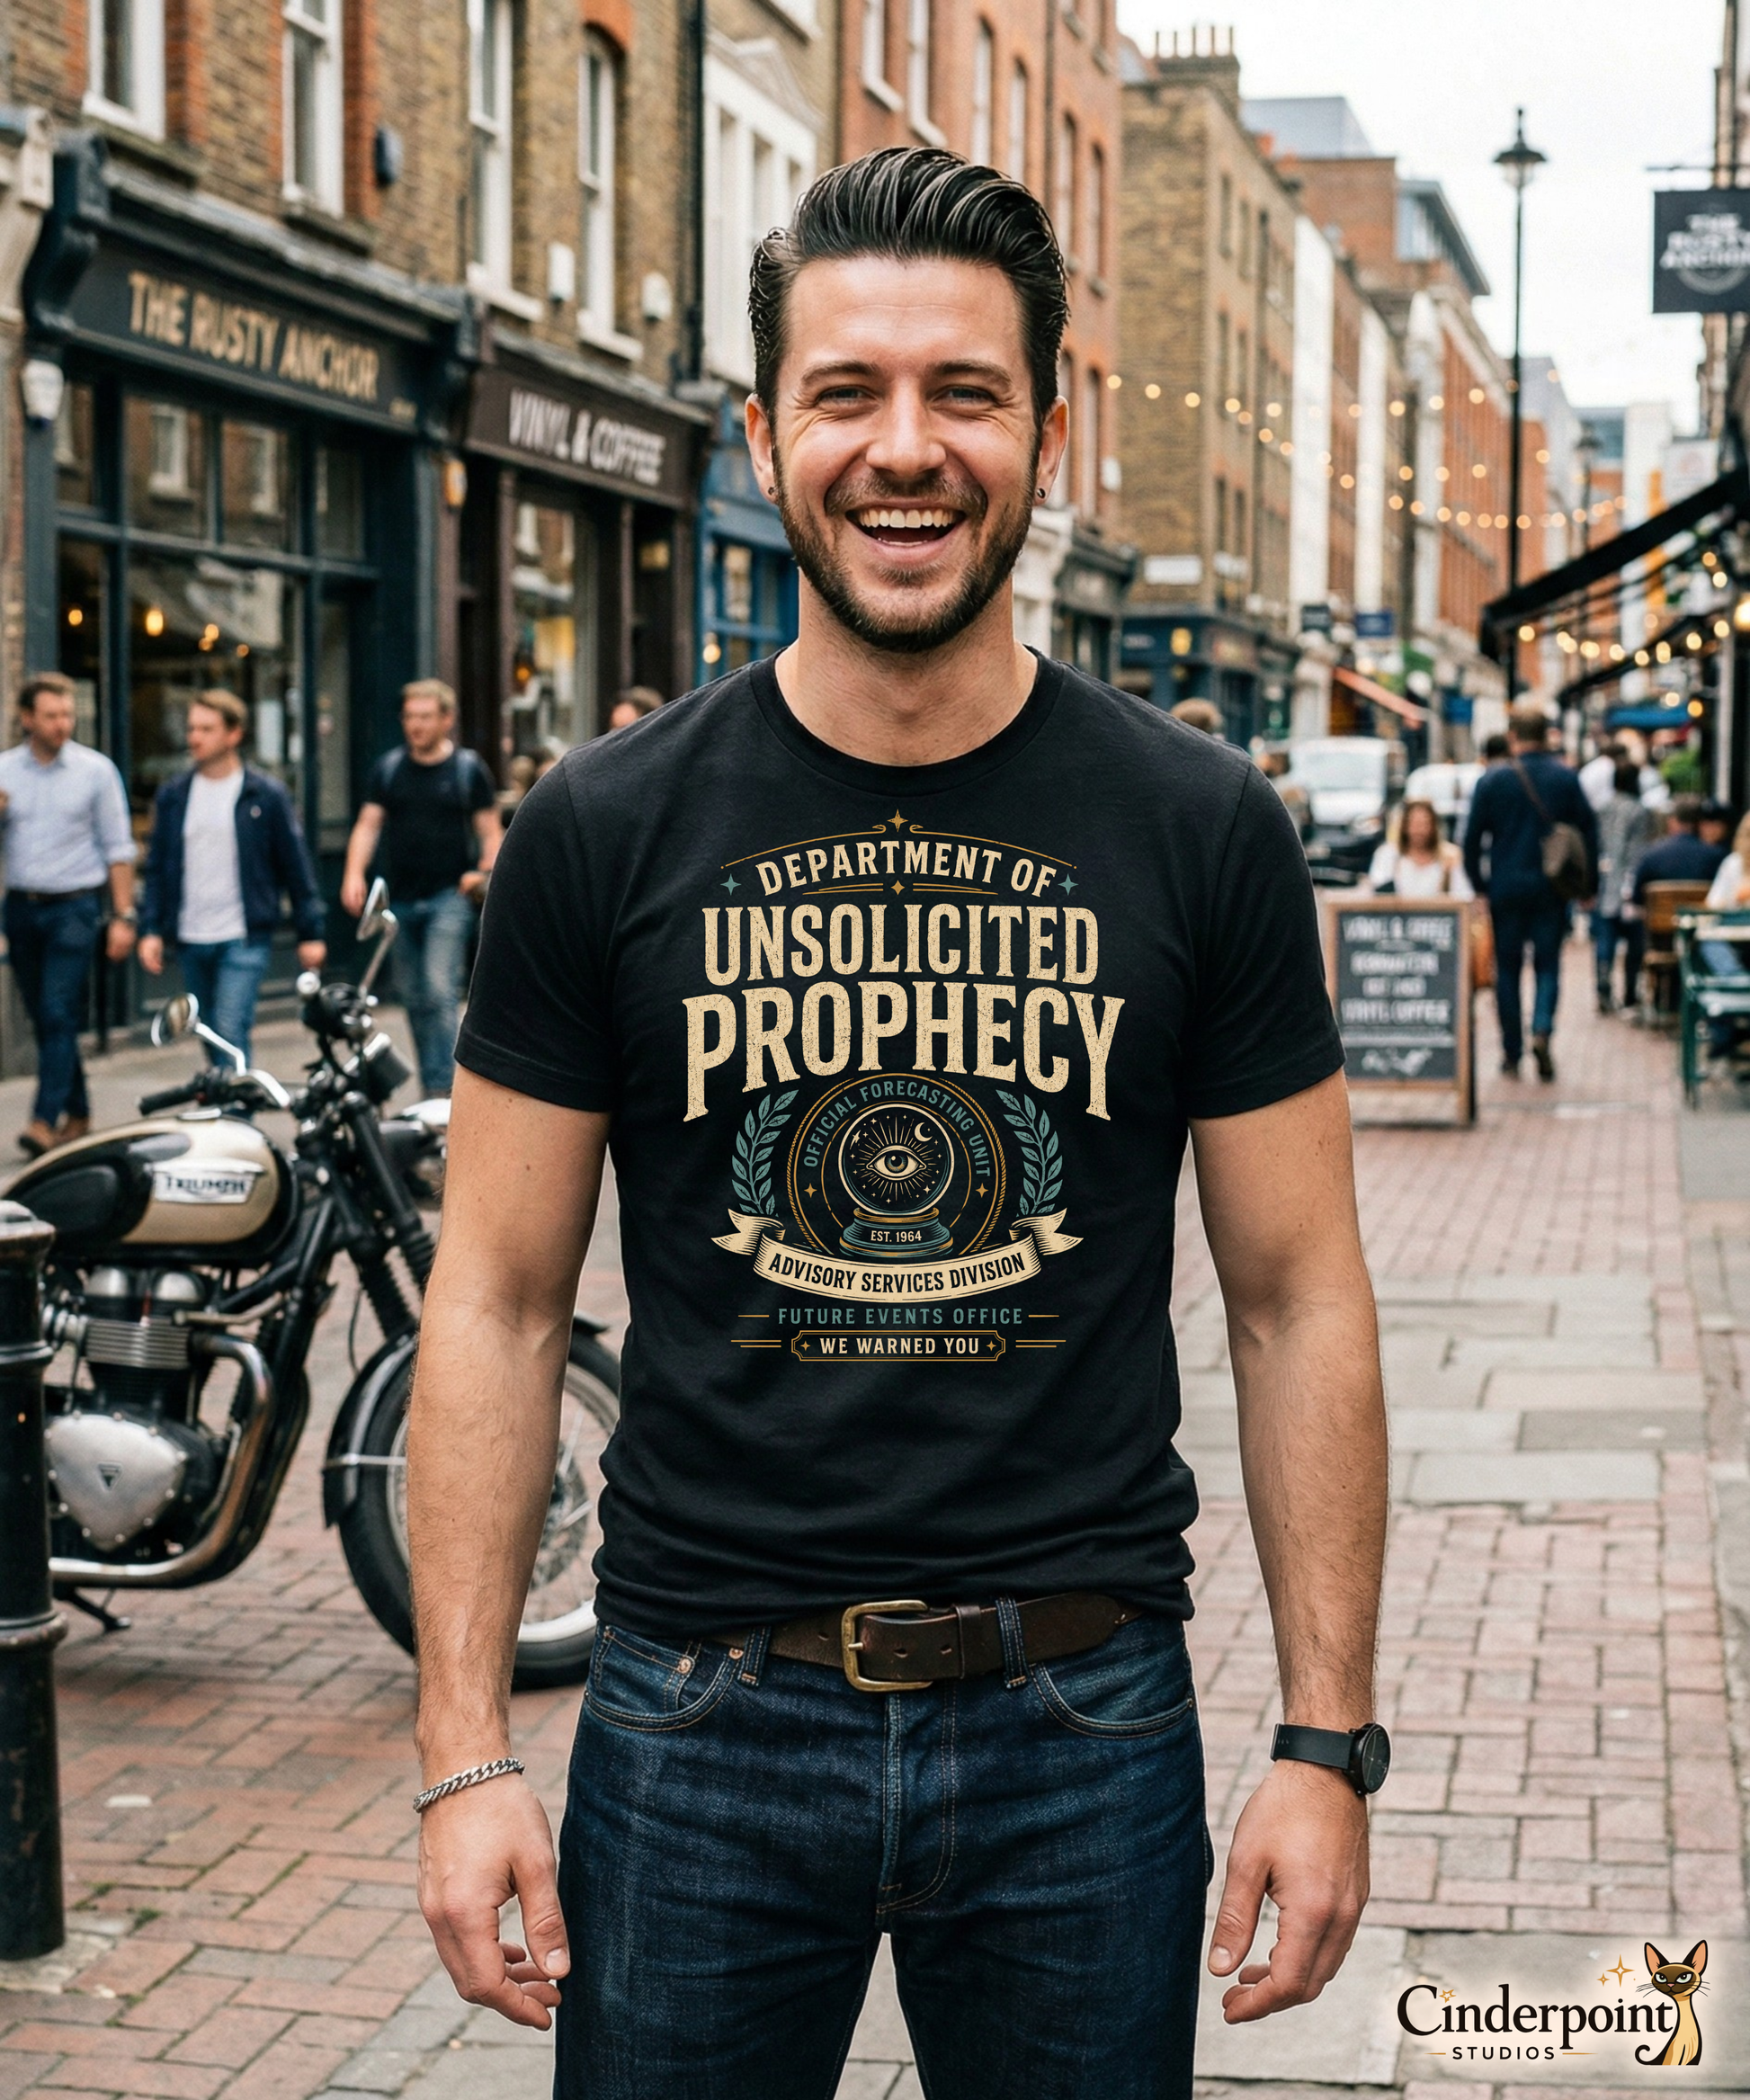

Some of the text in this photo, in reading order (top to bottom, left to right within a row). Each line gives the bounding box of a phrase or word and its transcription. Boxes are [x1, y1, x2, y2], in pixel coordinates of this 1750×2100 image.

[129, 271, 379, 401] THE RUSTY ANCHOR
[509, 388, 666, 487] VINYL & COFFEE
[755, 840, 1058, 898] DEPARTMENT OF
[701, 903, 1099, 986] UNSOLICITED
[682, 980, 1126, 1122] PROPHECY
[803, 1080, 991, 1177] OFFICIAL FORECASTING UNIT
[165, 1175, 246, 1195] TRIUMPH
[870, 1229, 923, 1243] EST. 1964
[768, 1252, 1026, 1293] ADVISORY SERVICES DIVISION
[778, 1308, 1022, 1325] FUTURE EVENTS OFFICE
[819, 1337, 979, 1354] WE WARNED YOU
